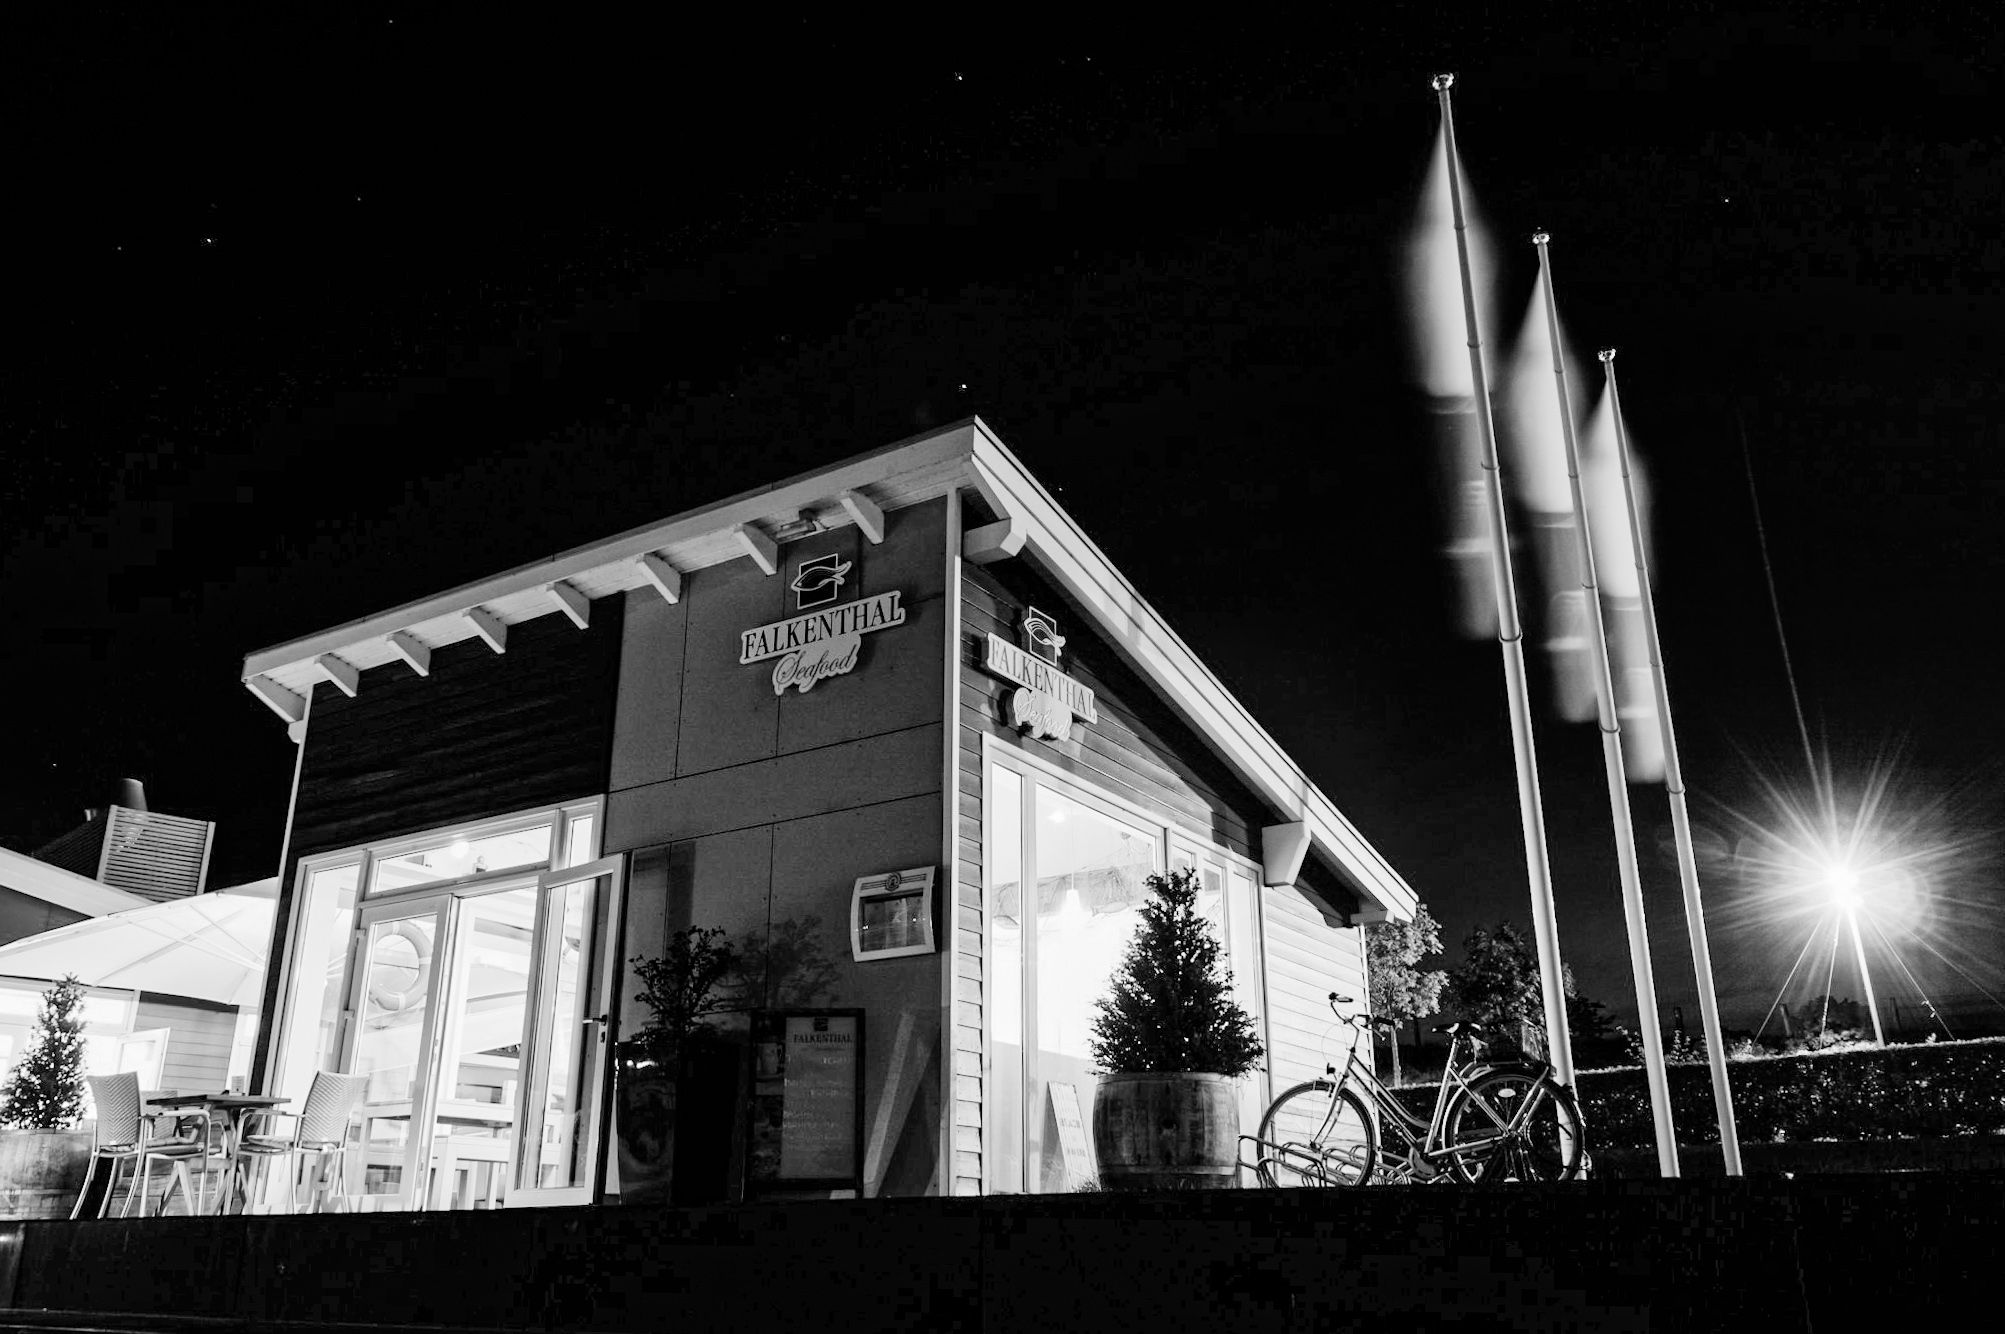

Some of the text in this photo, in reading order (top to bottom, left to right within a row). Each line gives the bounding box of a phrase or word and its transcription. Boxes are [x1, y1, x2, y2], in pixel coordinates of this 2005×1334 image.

[743, 595, 903, 660] FALKENTHAL
[775, 644, 857, 689] Seafood
[991, 639, 1096, 719] FALKENTHAL
[793, 1033, 852, 1043] FALKENTHAL
